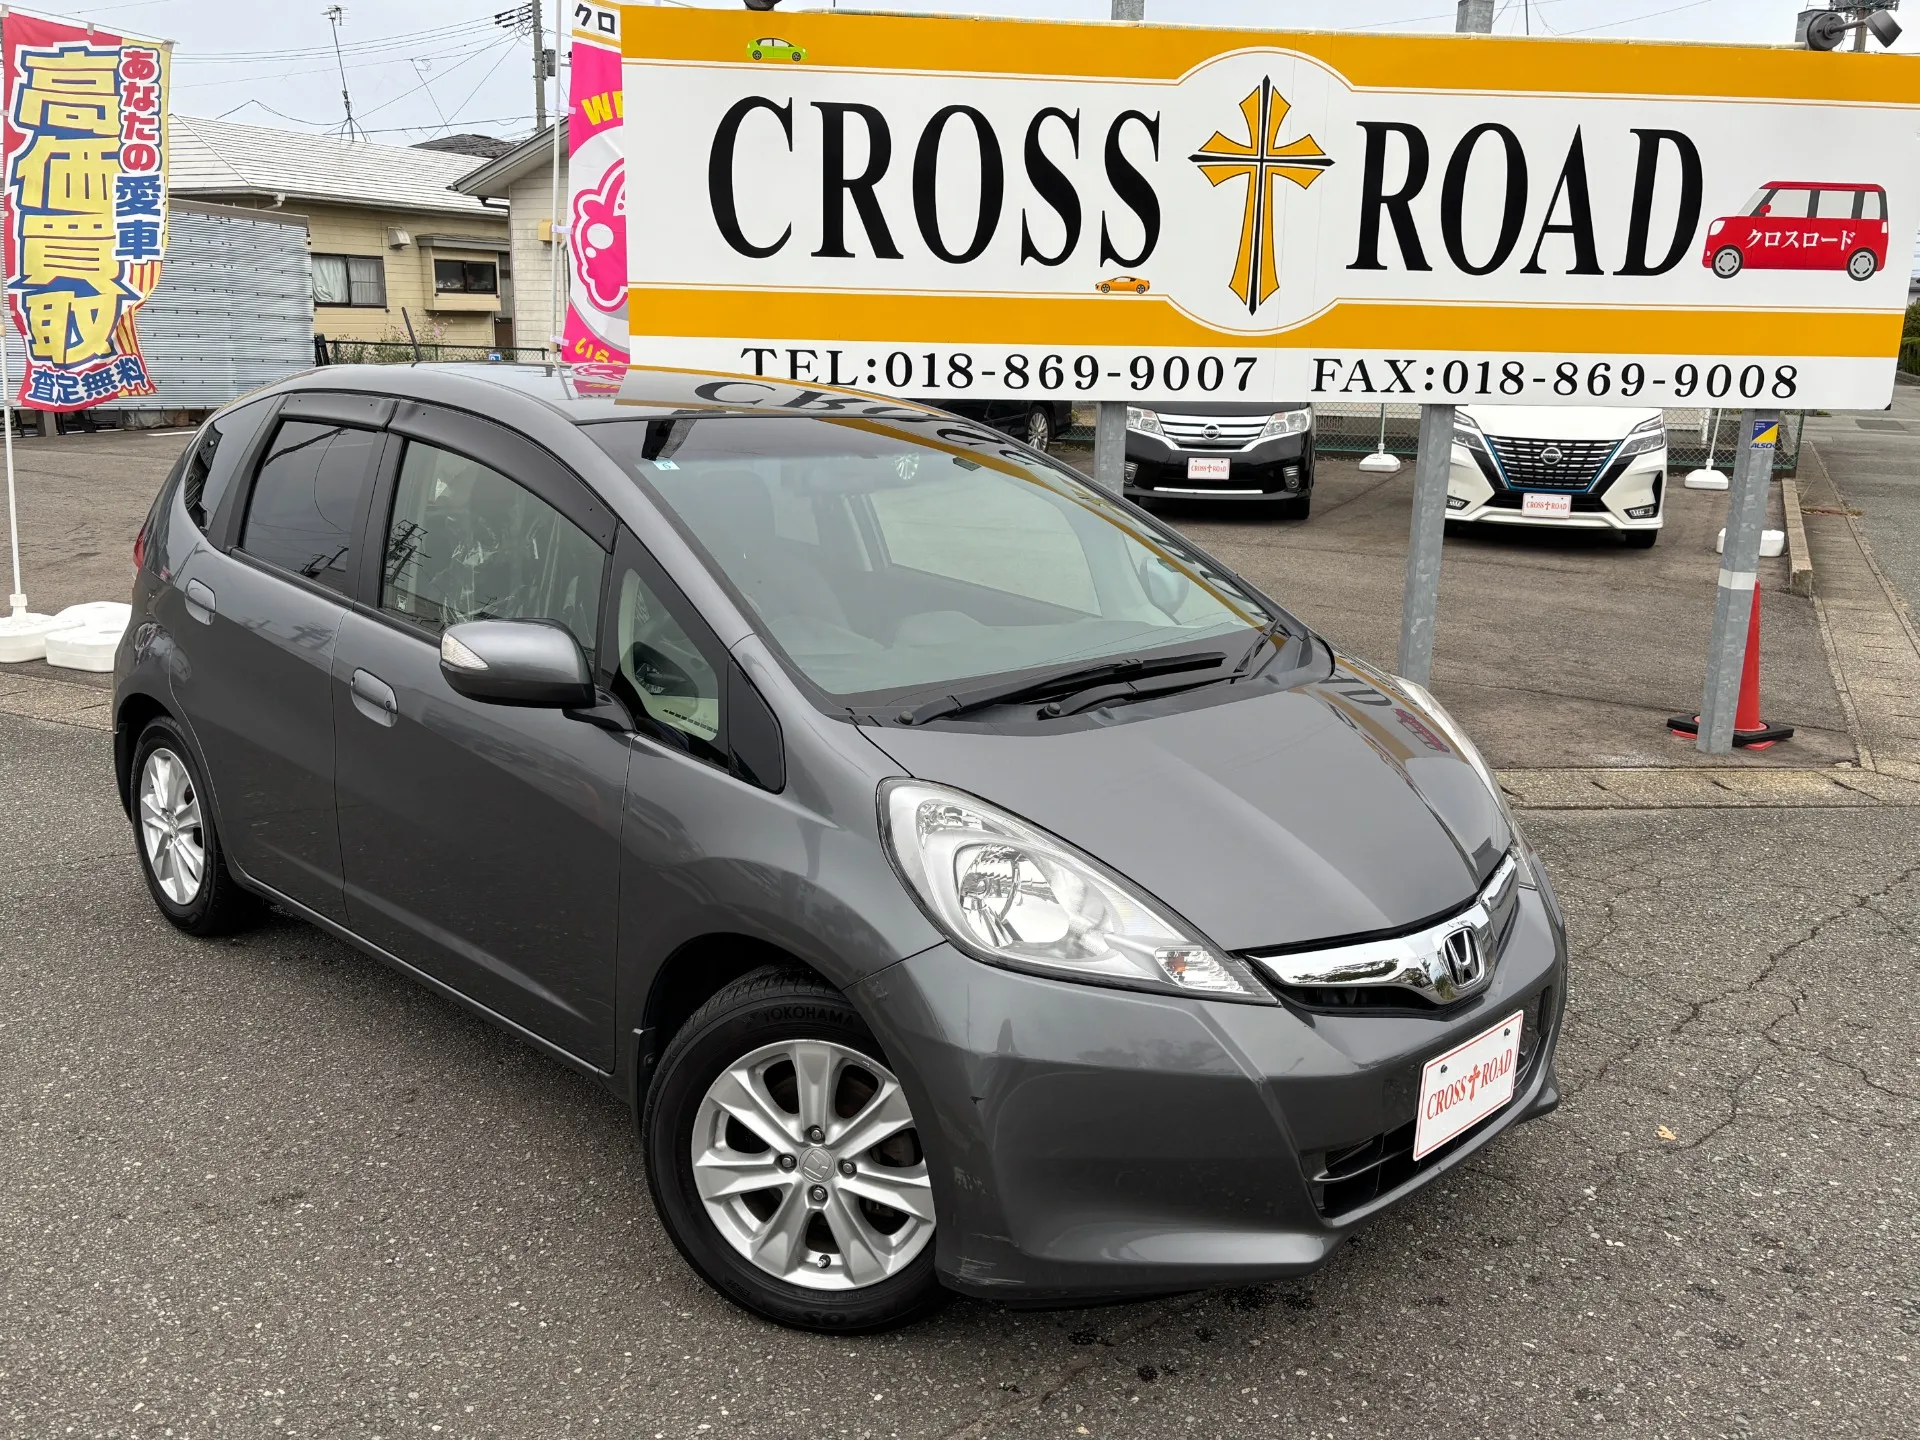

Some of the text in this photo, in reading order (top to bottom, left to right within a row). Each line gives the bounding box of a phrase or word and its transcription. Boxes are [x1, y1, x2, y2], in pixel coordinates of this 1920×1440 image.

[575, 3, 615, 34] クロ
[115, 50, 161, 260] あなたの愛車
[15, 50, 119, 364] 高価買取
[708, 95, 1703, 276] CROSS ROAD
[1745, 228, 1856, 251] クロスロード
[28, 357, 146, 404] 査定無料
[741, 348, 1798, 398] TEL:018-869-9007 FAX:018-869-9008
[1551, 502, 1567, 510] ROAD
[1427, 1049, 1512, 1120] CROSS ROAD
